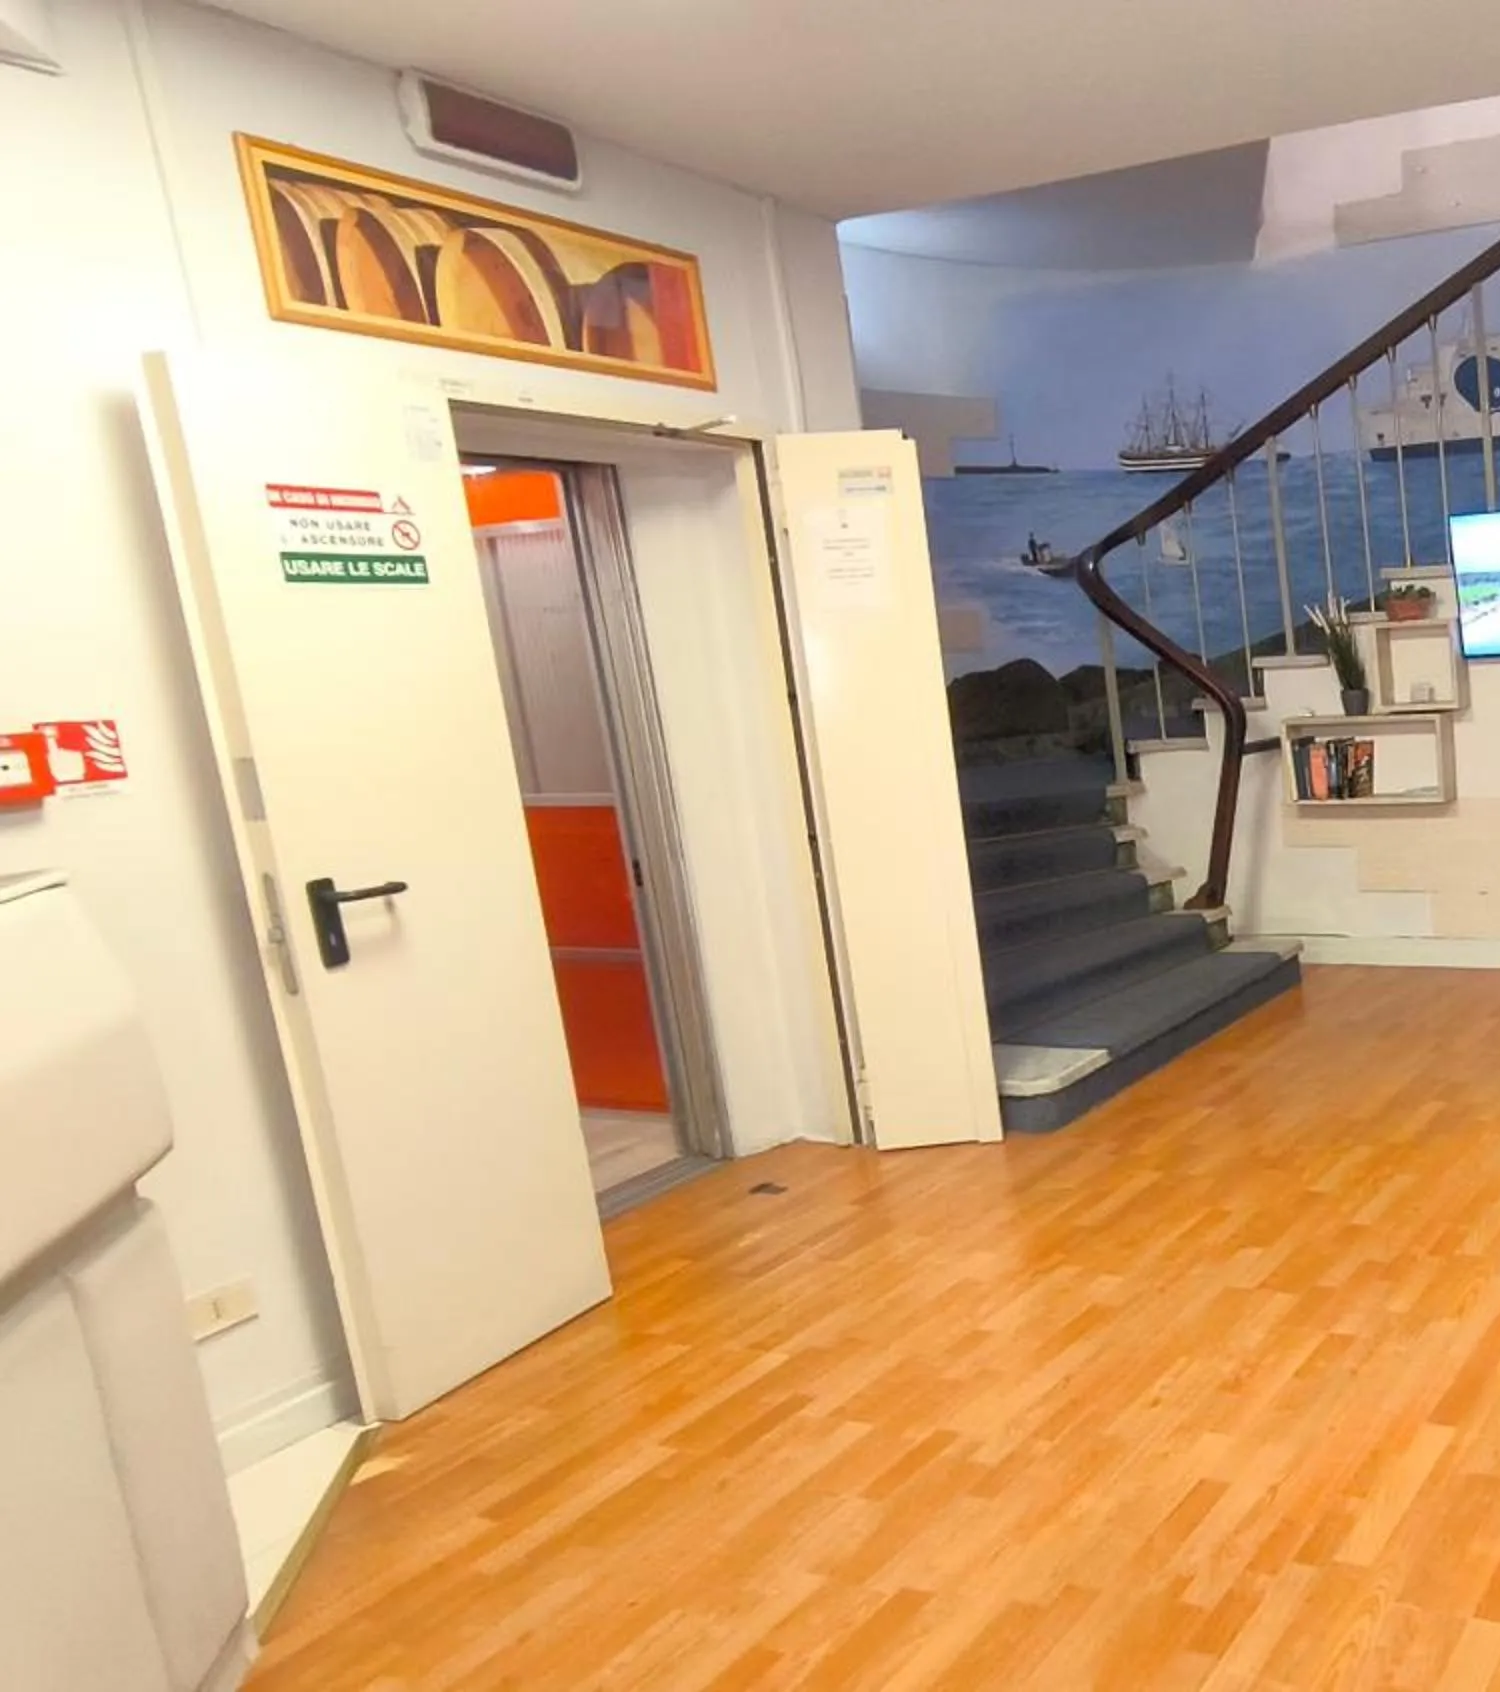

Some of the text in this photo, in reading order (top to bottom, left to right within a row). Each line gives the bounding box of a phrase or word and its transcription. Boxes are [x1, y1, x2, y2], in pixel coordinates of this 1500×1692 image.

[289, 518, 371, 531] NON USARE
[301, 534, 384, 547] ASCENSORE
[283, 559, 426, 577] USARE LE SCALE
